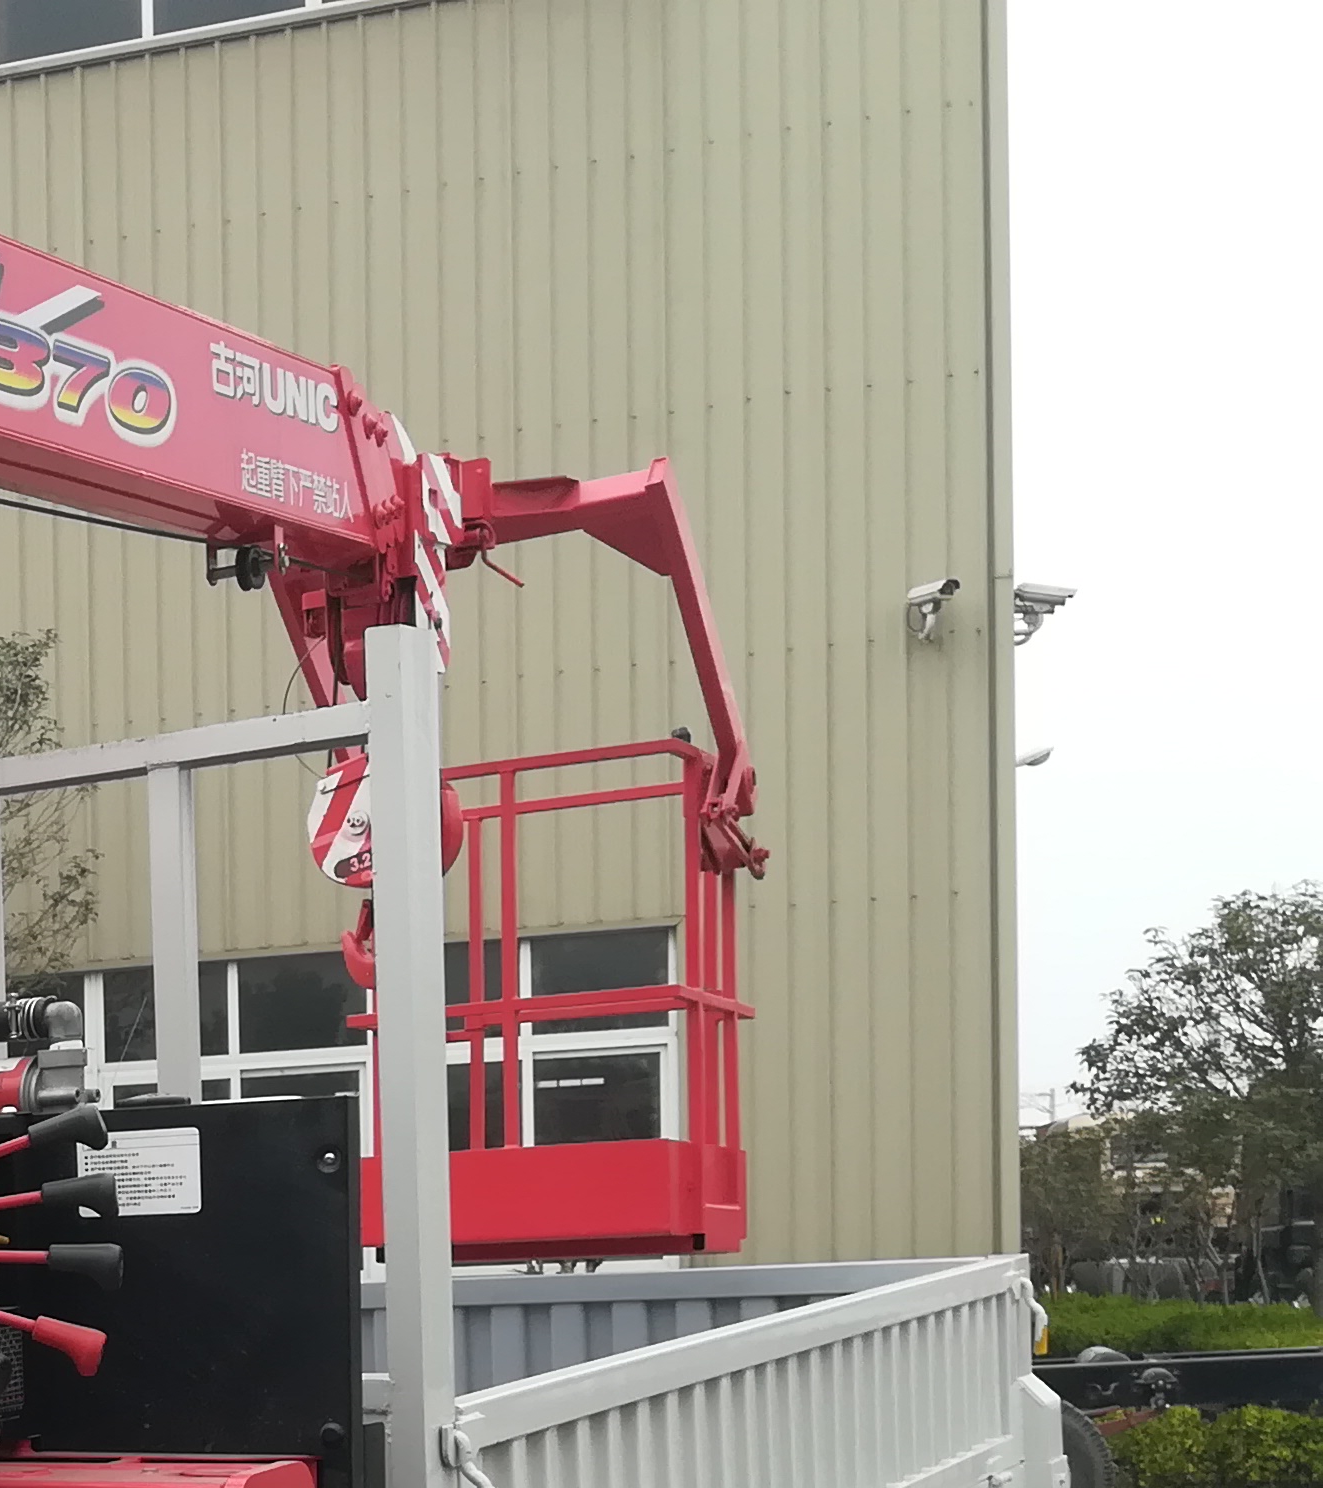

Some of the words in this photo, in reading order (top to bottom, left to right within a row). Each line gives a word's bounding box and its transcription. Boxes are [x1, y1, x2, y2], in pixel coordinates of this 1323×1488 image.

[240, 447, 355, 524] 起重臂下严禁站人
